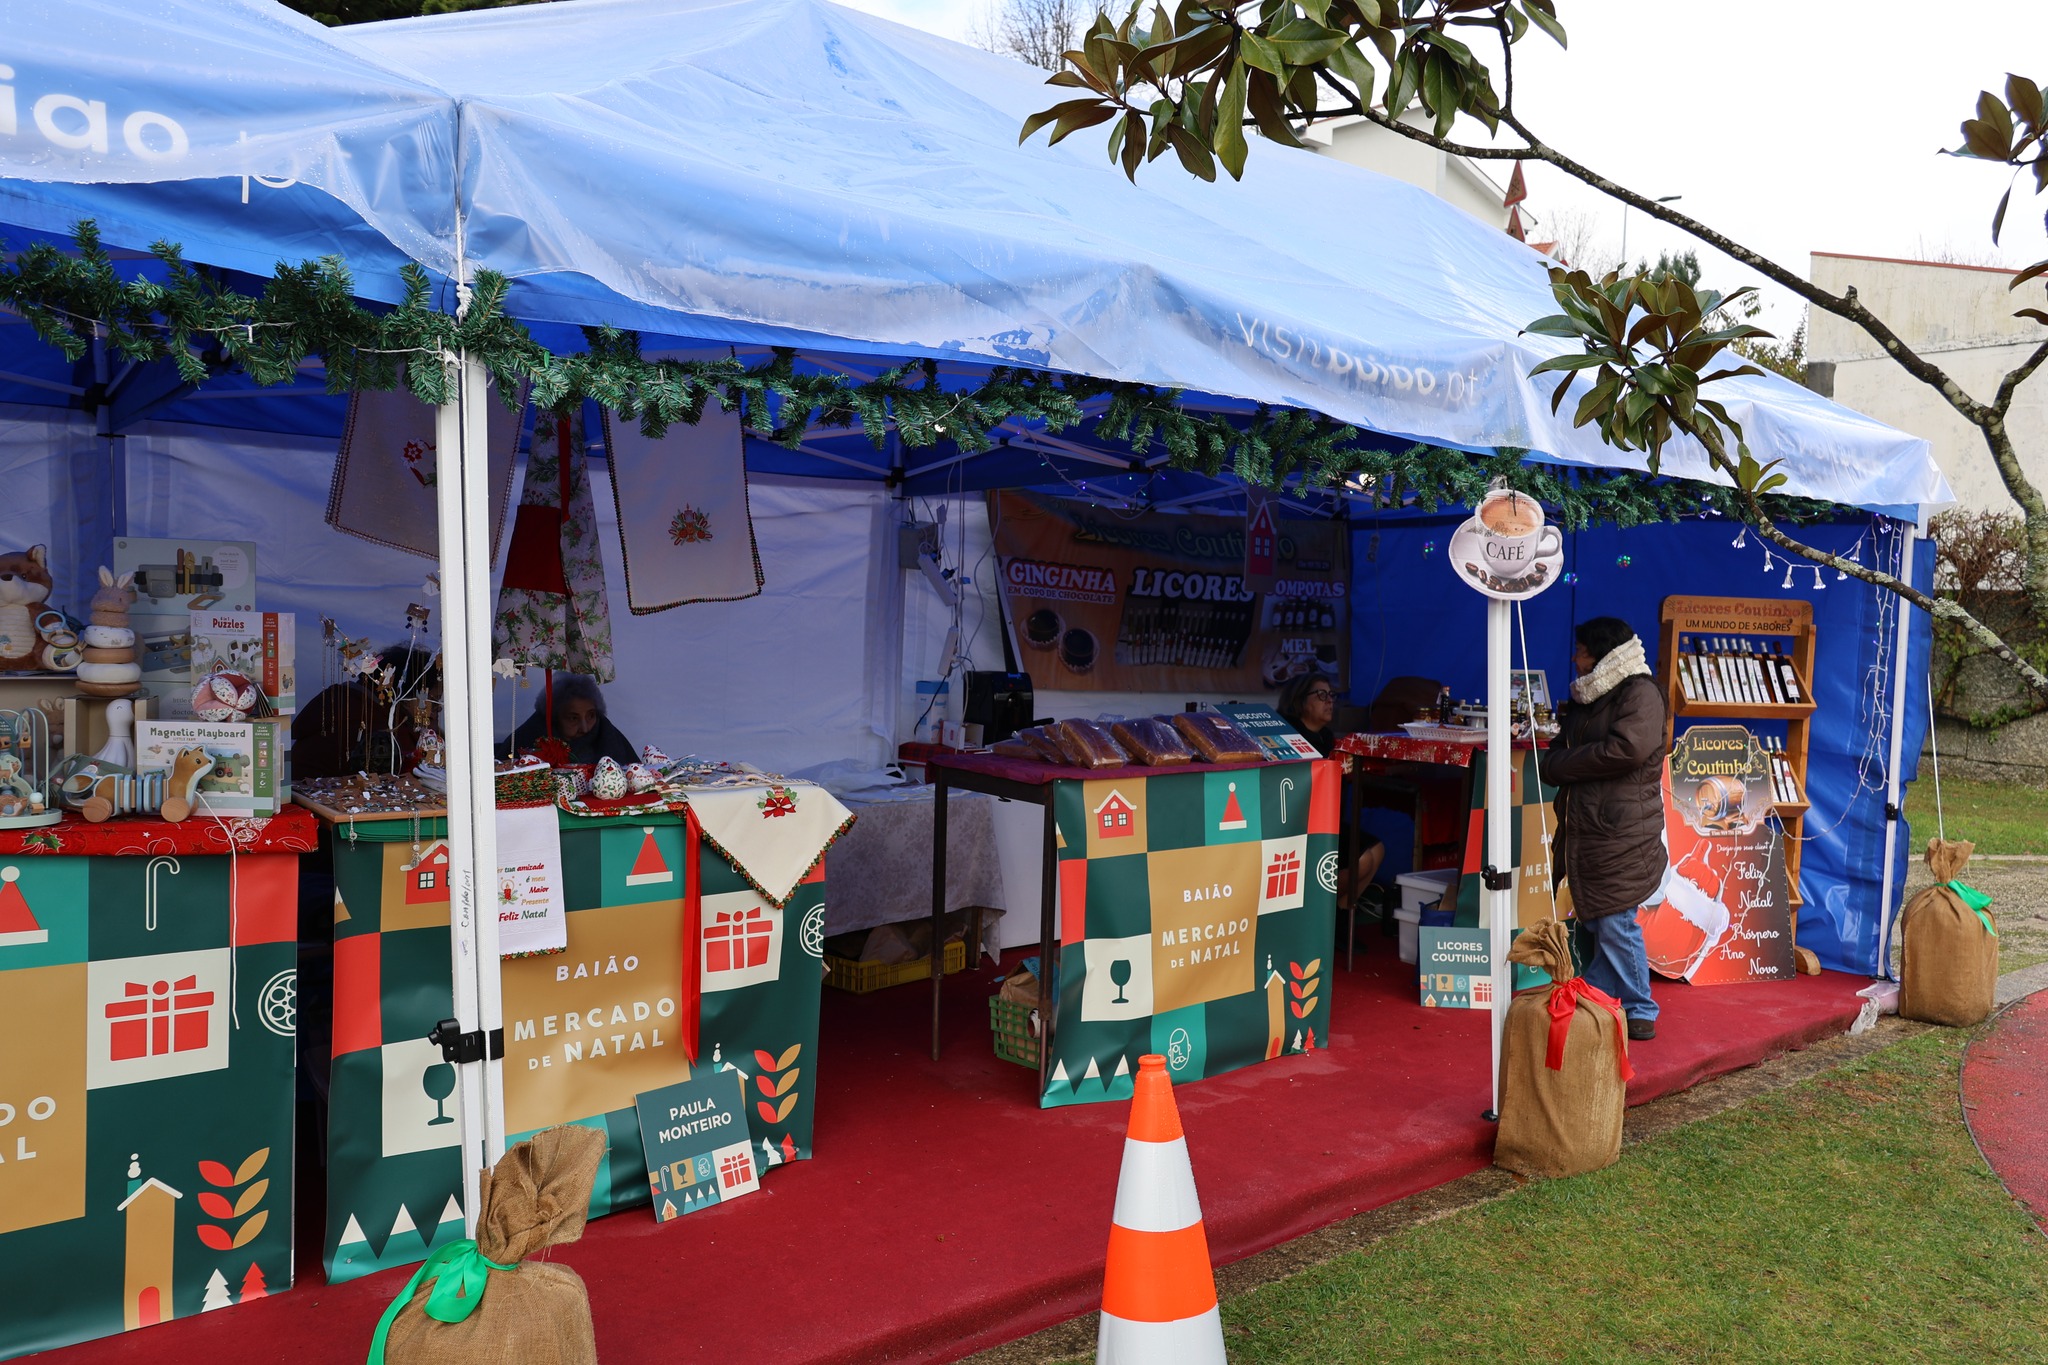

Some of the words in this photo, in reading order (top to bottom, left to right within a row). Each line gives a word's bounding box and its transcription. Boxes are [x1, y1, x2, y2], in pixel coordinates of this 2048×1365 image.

[1486, 541, 1525, 560] CAFÉ
[1009, 562, 1116, 592] GINGINHA
[1131, 569, 1254, 602] LICORES
[1267, 578, 1346, 597] OMPOTAS
[1007, 586, 1021, 594] EM
[1023, 587, 1045, 597] COPO
[1046, 589, 1057, 598] DE
[1058, 591, 1114, 603] CHOCOLATE
[1676, 600, 1732, 615] Licores
[1734, 602, 1801, 617] Coutinho
[212, 618, 245, 629] Puzzles
[1685, 619, 1700, 628] UM
[1702, 620, 1736, 630] MUNDO
[1738, 621, 1751, 631] DE
[1752, 622, 1791, 632] SABORES
[1281, 638, 1317, 653] MEL
[1234, 712, 1271, 720] BISCOITO
[1249, 720, 1286, 728] TEIXEIRA
[150, 727, 195, 739] Magnetic
[197, 728, 246, 740] Playboard
[1692, 736, 1744, 751] Licores
[1687, 759, 1753, 775] Coutinho
[517, 862, 545, 872] amizade
[1733, 861, 1764, 880] Feliz
[529, 886, 549, 894] Maior
[1183, 883, 1233, 903] BAIÃO
[1529, 886, 1539, 894] DE
[521, 897, 550, 906] Presente
[1737, 890, 1774, 909] Natal
[498, 911, 520, 922] Feliz
[521, 908, 548, 920] Natal
[1162, 918, 1249, 946] MERCADO
[1731, 922, 1780, 948] Próspero
[1170, 958, 1185, 968] DE
[1190, 941, 1240, 965] NATAL
[1437, 941, 1483, 951] LICORES
[1719, 943, 1746, 960] Ano
[1431, 952, 1489, 963] COUTINHO
[556, 955, 639, 982] BAIÃO
[1747, 957, 1779, 976] Novo
[514, 997, 675, 1042] MERCADO
[528, 1055, 552, 1071] DE
[563, 1029, 664, 1063] NATAL
[669, 1097, 716, 1121] PAULA
[658, 1112, 732, 1144] MONTEIRO
